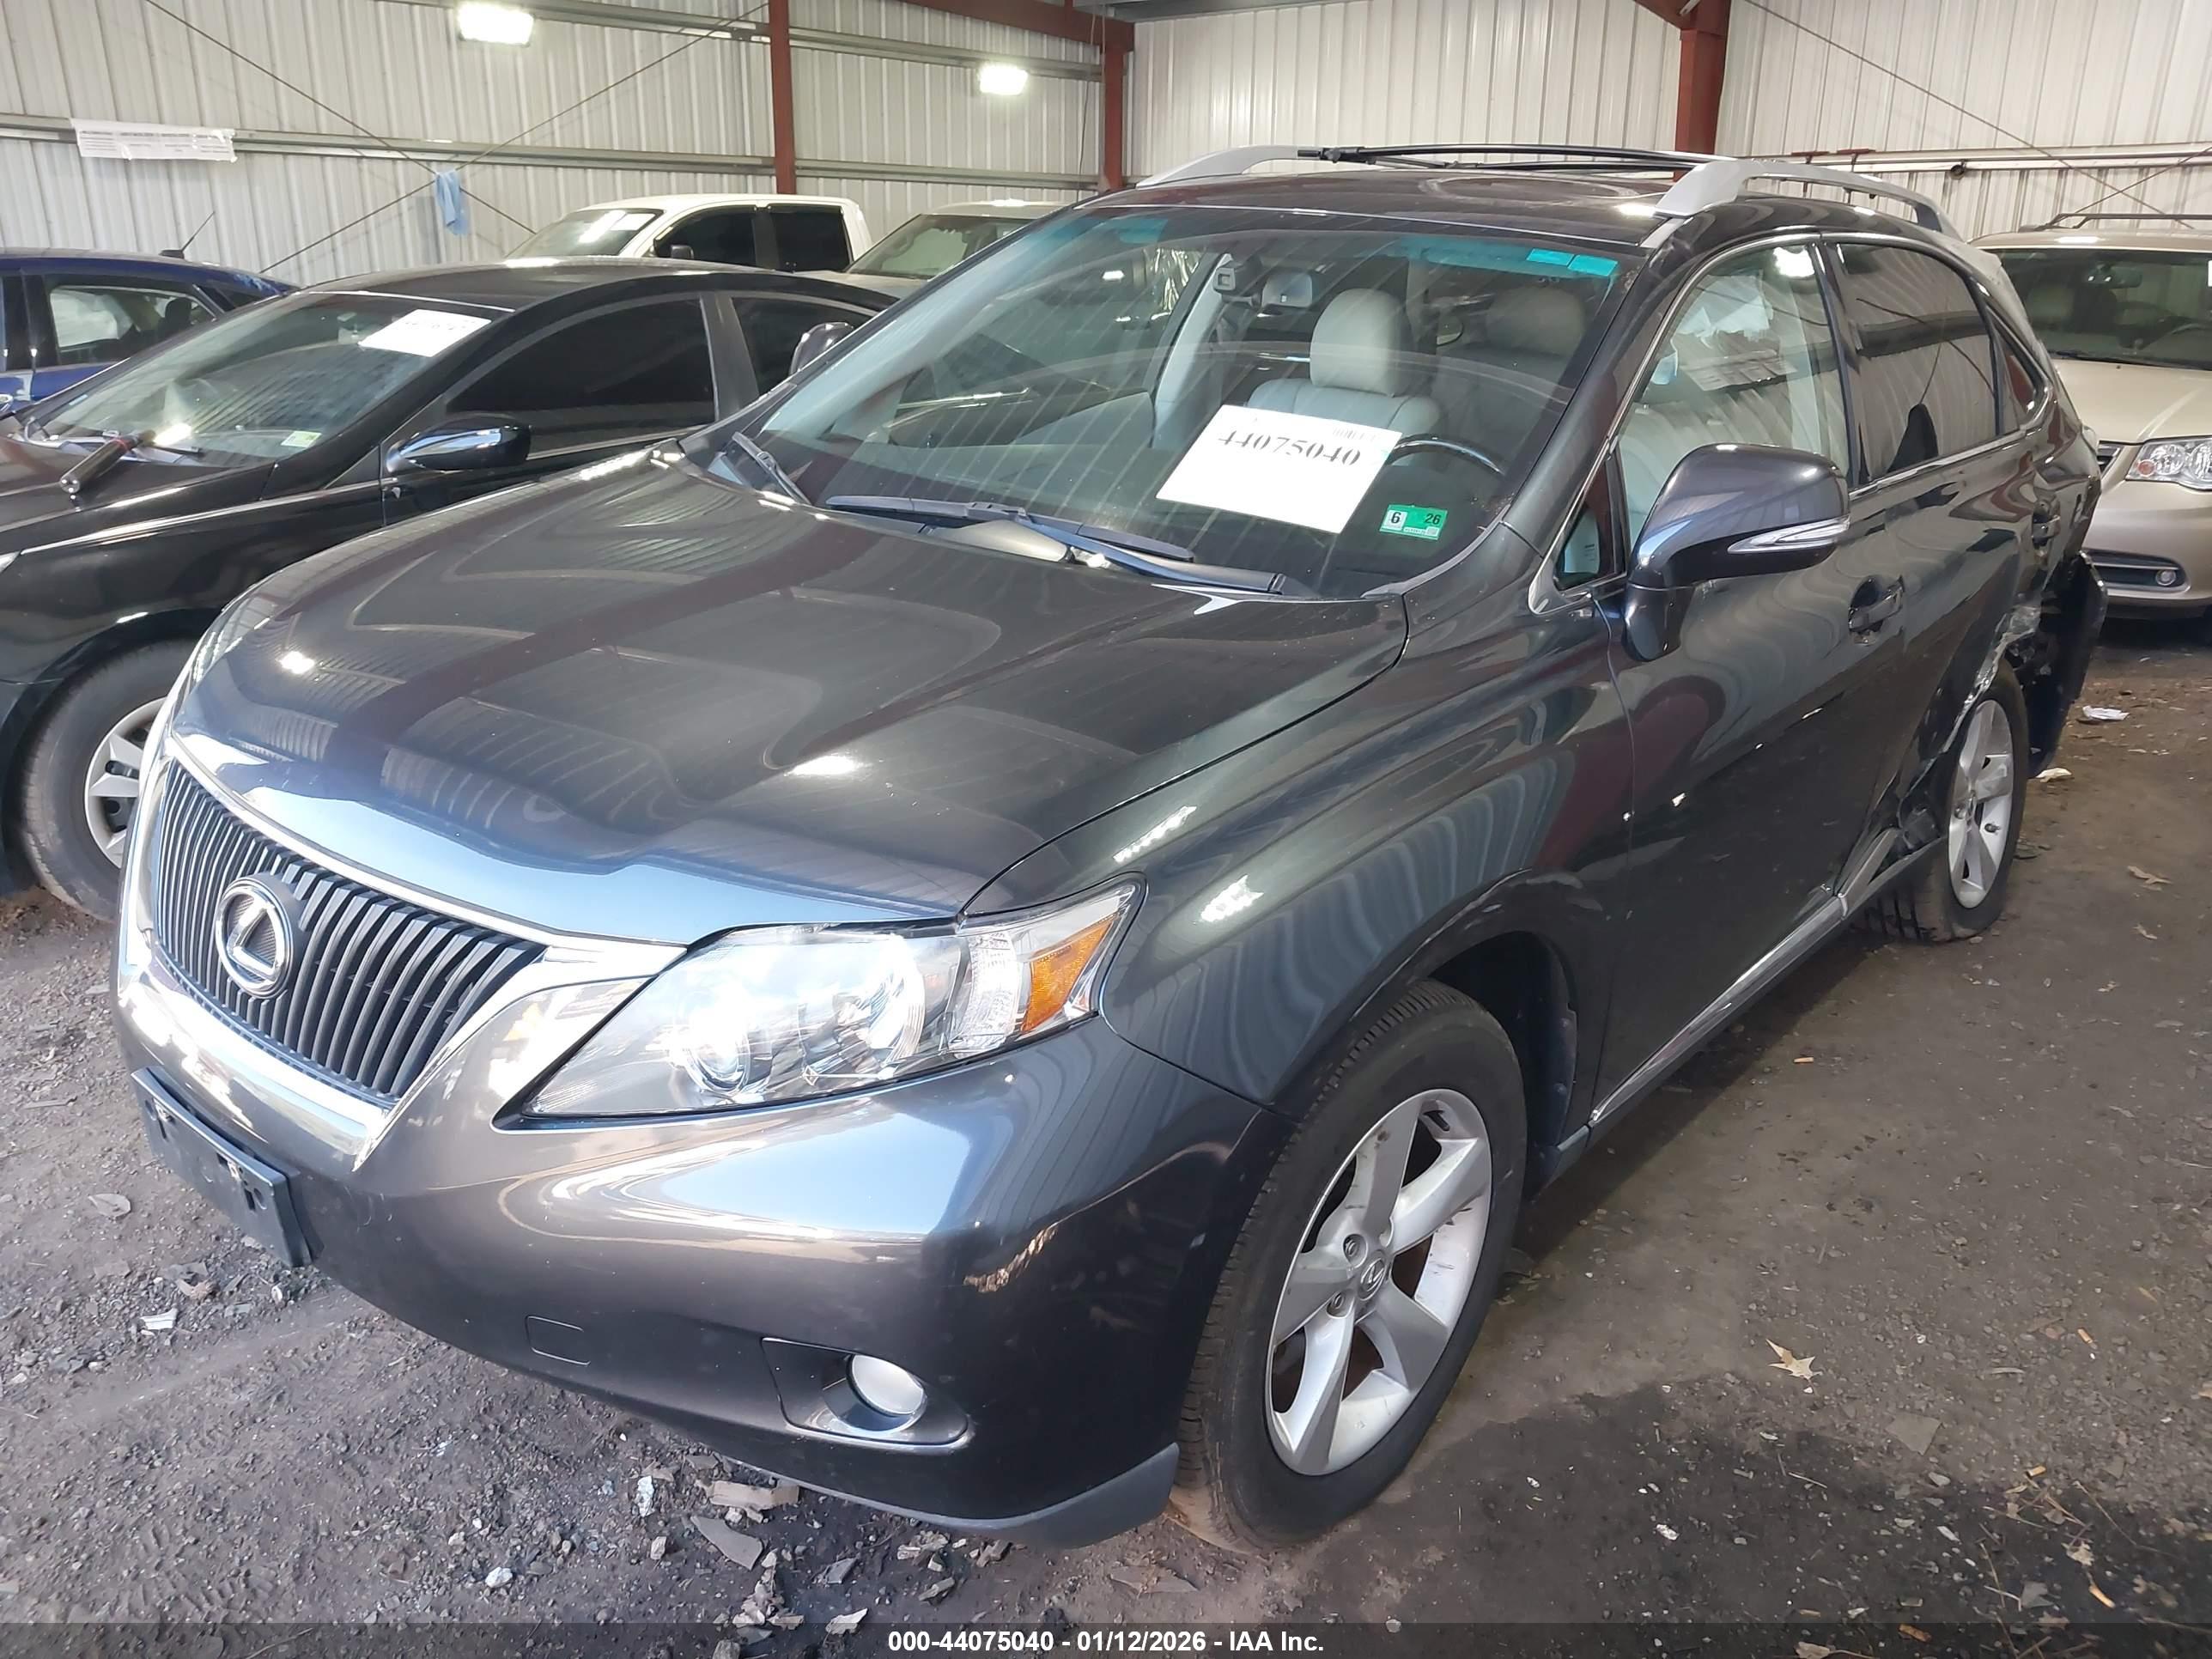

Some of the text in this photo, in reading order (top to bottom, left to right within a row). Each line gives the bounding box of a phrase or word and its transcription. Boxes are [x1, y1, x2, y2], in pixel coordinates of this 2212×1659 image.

[1218, 430, 1361, 466] 44075040
[1390, 511, 1442, 526] 6 26
